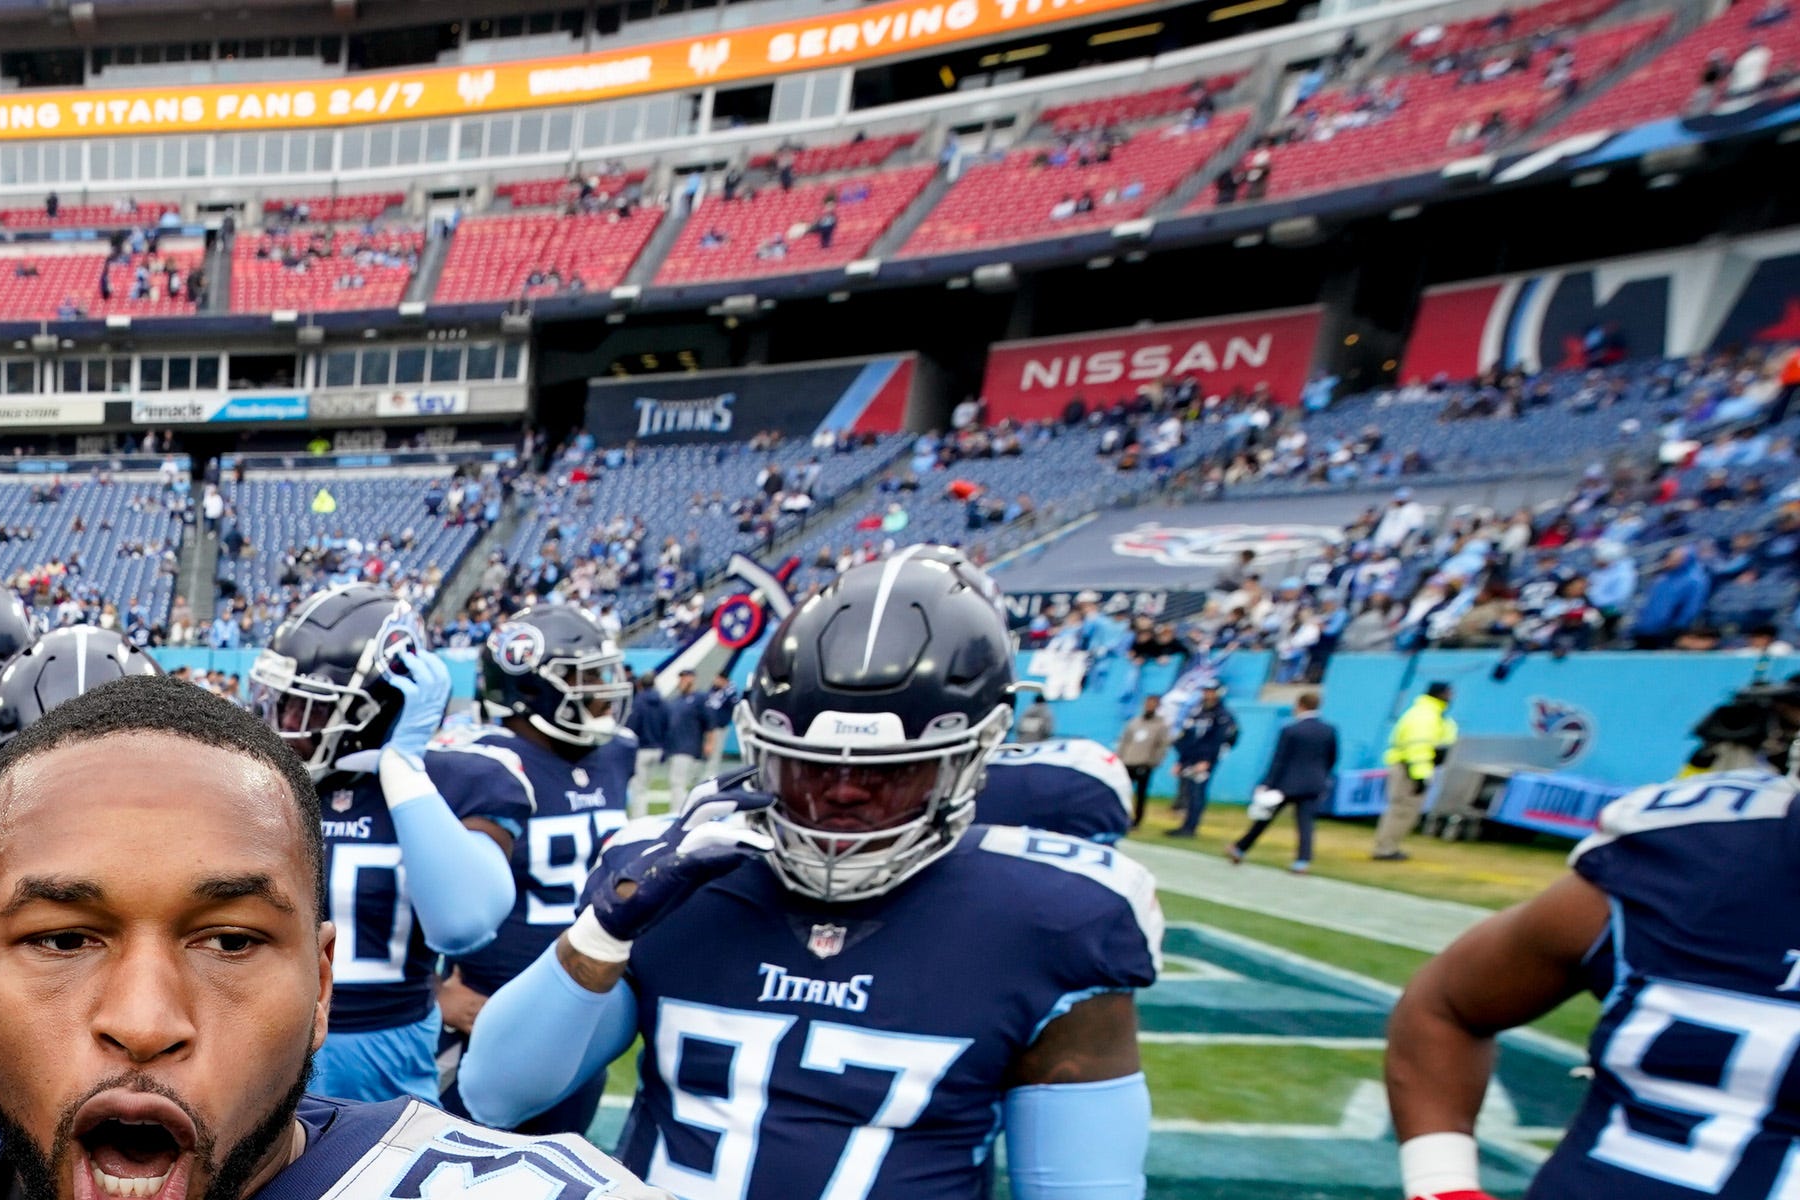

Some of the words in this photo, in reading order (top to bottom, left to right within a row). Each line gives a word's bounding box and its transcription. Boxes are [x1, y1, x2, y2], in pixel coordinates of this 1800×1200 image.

[767, 0, 979, 62] SERVING
[72, 95, 203, 126] TITANS
[216, 90, 317, 120] FANS
[329, 82, 424, 114] 24/7
[1020, 334, 1272, 391] NISSAN
[635, 393, 736, 437] TITANS
[1005, 592, 1168, 619] NISAN
[757, 962, 874, 1012] TITANS
